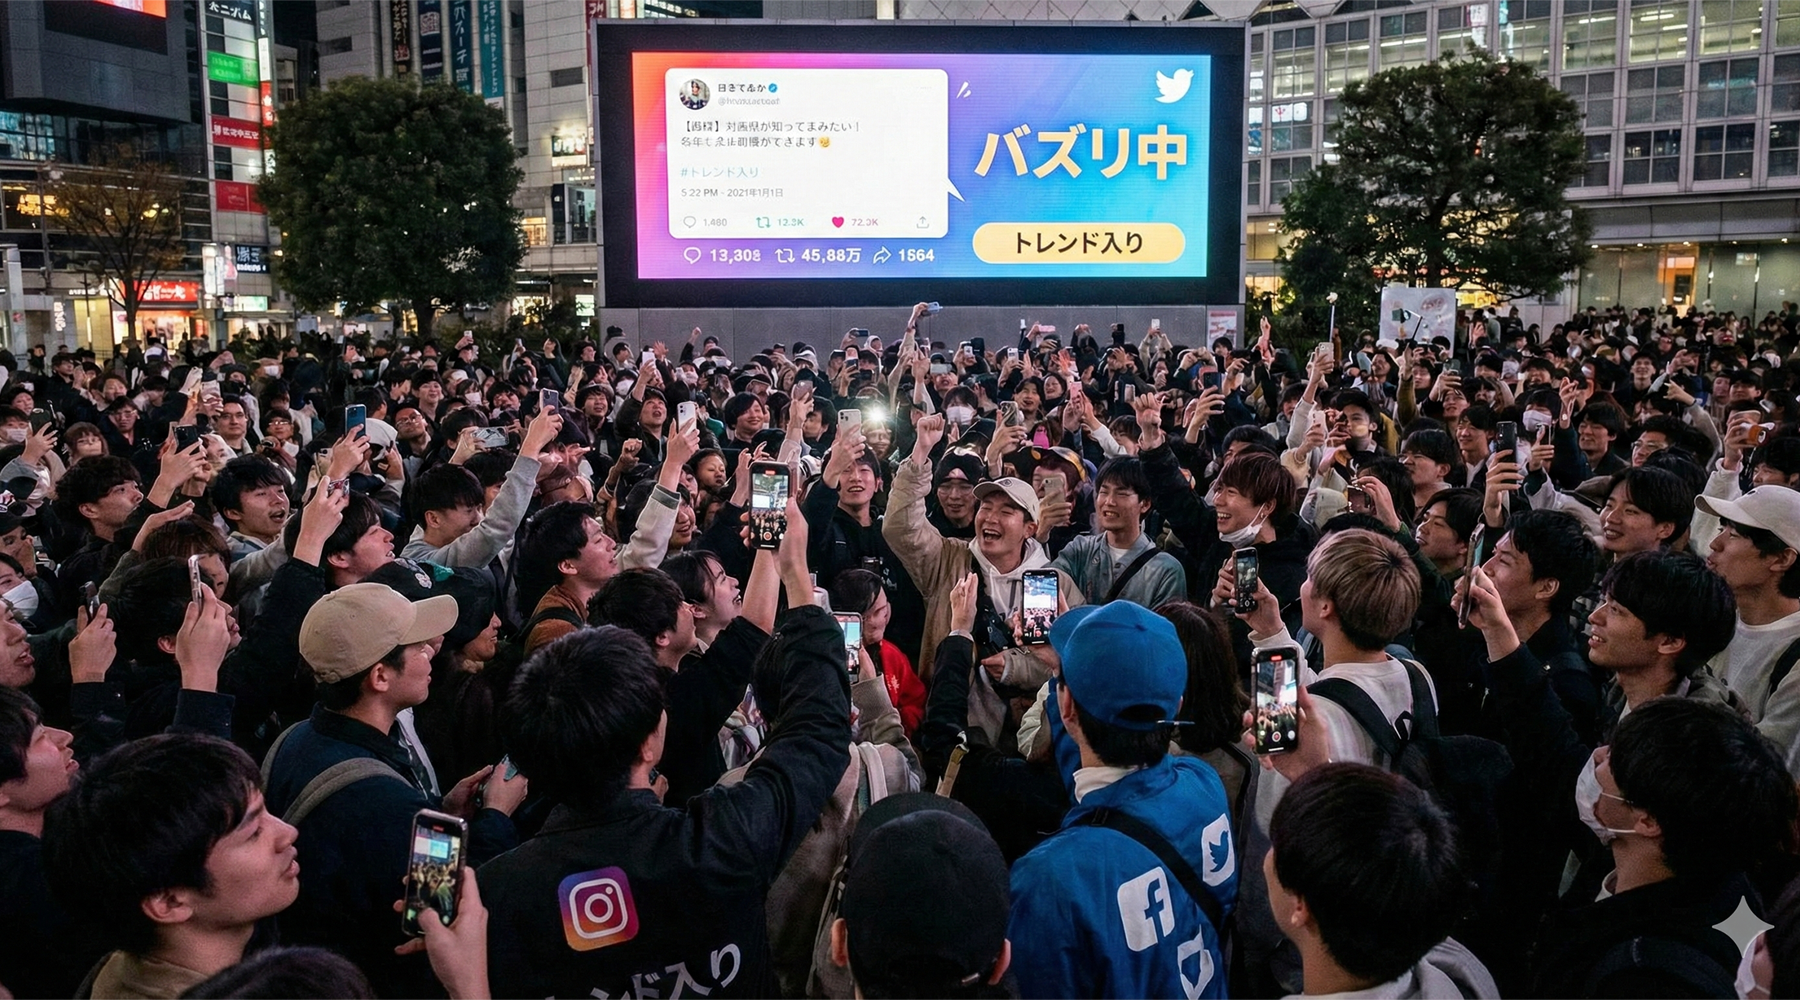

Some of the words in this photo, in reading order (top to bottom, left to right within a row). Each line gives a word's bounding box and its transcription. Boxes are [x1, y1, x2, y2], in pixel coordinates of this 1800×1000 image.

[974, 123, 1187, 181] バズリ中
[681, 167, 759, 178] #トレンド入り
[681, 188, 701, 197] 522
[703, 188, 718, 197] PM
[727, 188, 783, 198] 2021年1月1日
[1017, 231, 1143, 254] トレンド入り
[801, 248, 862, 264] 45,88万
